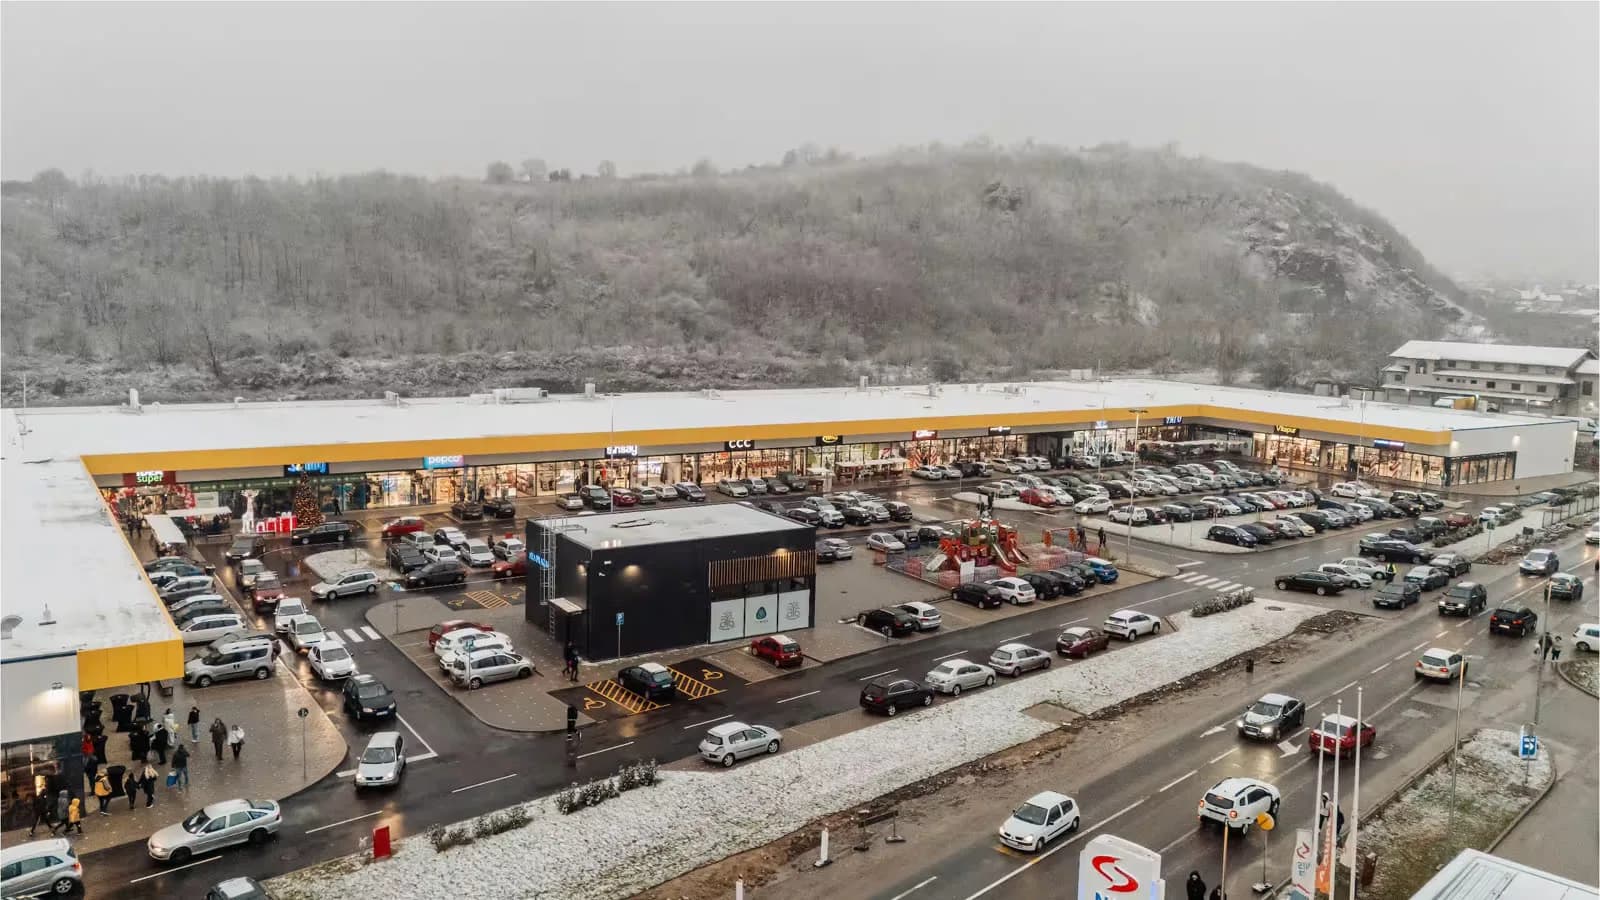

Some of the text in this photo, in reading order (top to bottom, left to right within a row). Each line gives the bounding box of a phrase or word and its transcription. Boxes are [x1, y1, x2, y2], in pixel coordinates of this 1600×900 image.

[729, 440, 751, 448] CCC
[428, 456, 460, 465] pepco
[137, 475, 163, 484] super
